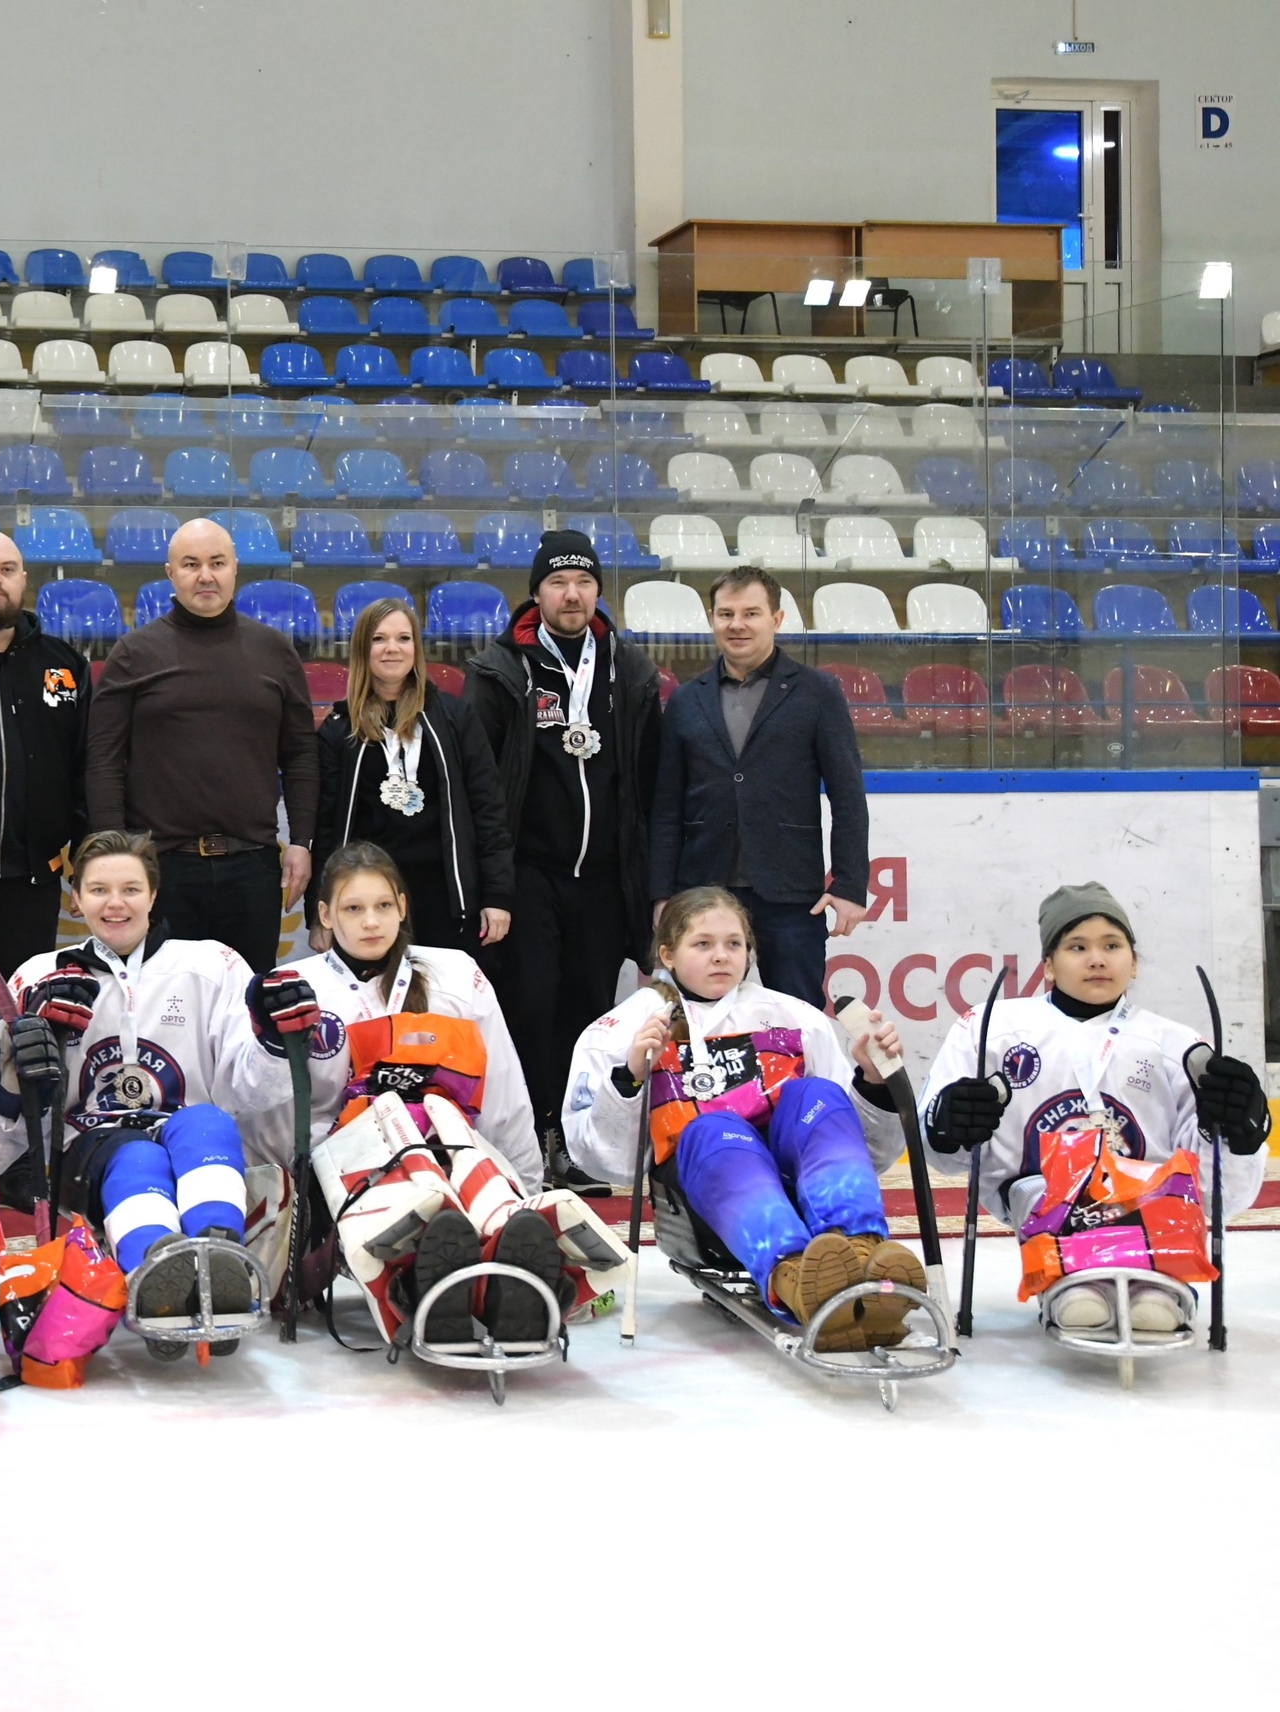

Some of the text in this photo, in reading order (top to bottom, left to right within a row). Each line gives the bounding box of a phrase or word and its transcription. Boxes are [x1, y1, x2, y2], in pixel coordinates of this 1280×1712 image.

[1059, 43, 1094, 53] ЫХОД
[1197, 94, 1234, 104] СЕКТОР
[1202, 107, 1230, 139] D
[552, 559, 591, 569] HOCKEY
[862, 857, 908, 922] Я
[823, 953, 1053, 1021] ОССИ
[160, 1014, 186, 1024] ОРТО
[89, 1046, 167, 1077] НЕЖАЯ
[1126, 1075, 1152, 1090] ОРТО
[1035, 1099, 1129, 1133] СНЕЖАЯ
